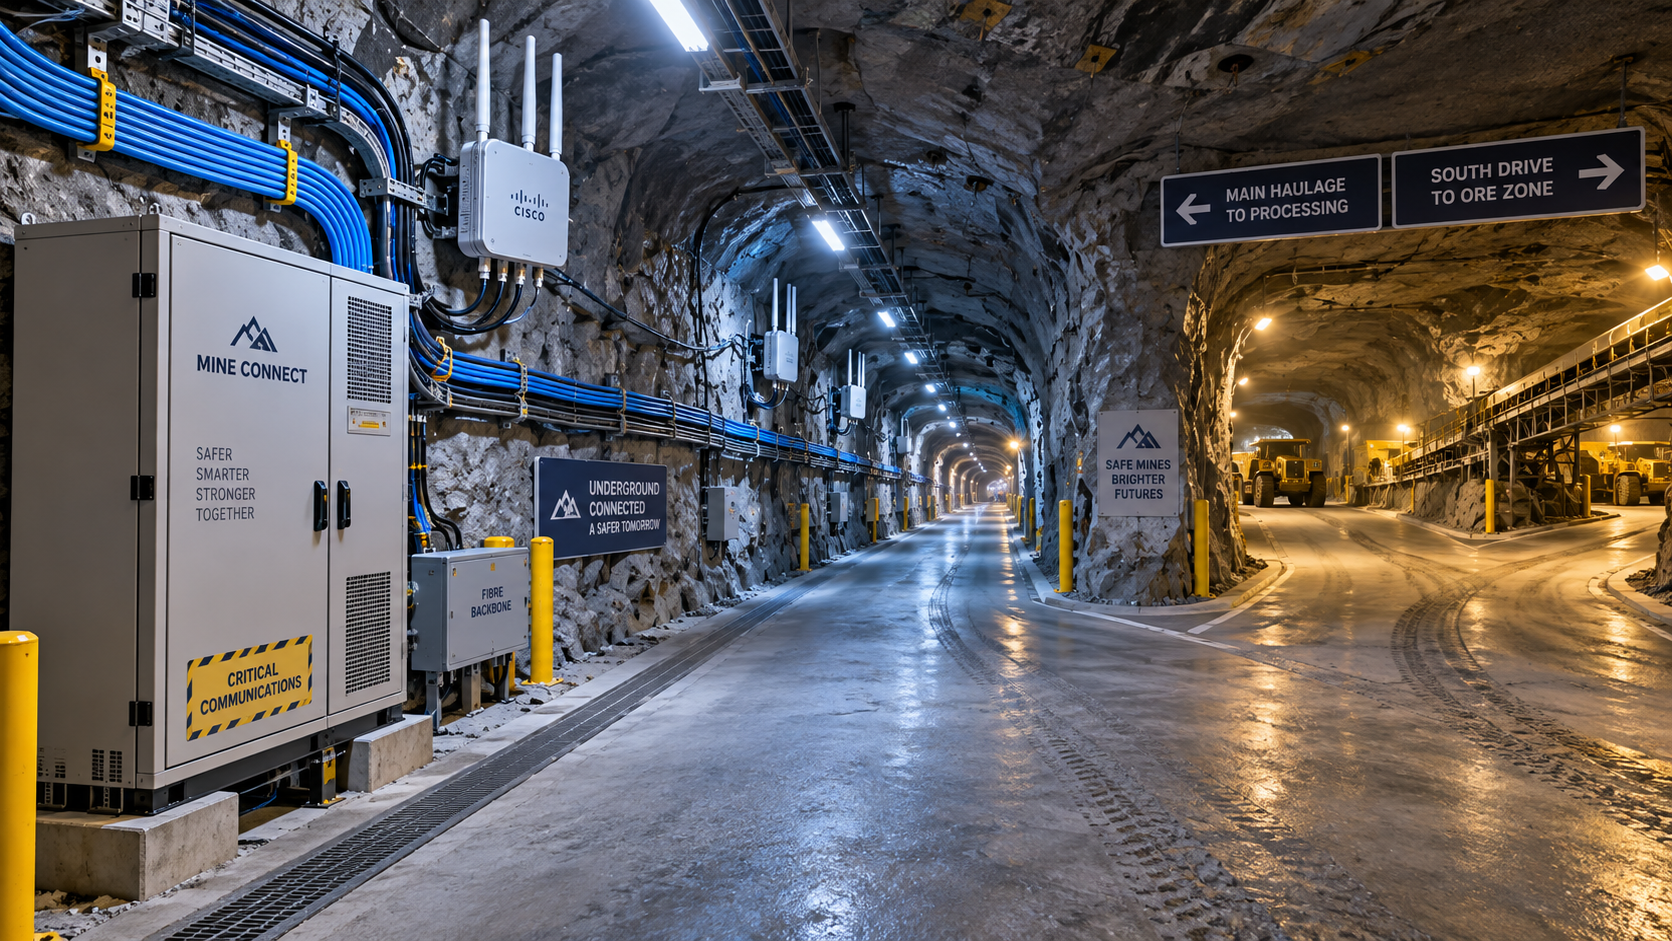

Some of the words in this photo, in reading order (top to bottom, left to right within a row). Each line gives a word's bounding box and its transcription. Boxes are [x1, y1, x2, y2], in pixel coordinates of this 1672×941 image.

[1432, 164, 1491, 183] SOUTH
[1499, 158, 1553, 176] DRIVE
[1227, 186, 1265, 202] MAIN
[1271, 178, 1345, 198] HAULAGE
[1431, 190, 1455, 205] TO
[1461, 186, 1496, 202] ORE
[1503, 181, 1553, 199] ZONE
[514, 206, 545, 221] CISCO
[1226, 209, 1245, 222] TO
[1250, 199, 1349, 221] PROCESSING
[197, 355, 236, 375] MINE
[241, 361, 307, 383] CONNECT
[197, 447, 232, 460] SAFER
[1106, 460, 1132, 470] SAFE
[1137, 460, 1171, 470] MINES
[197, 467, 249, 480] SMARTER
[1112, 474, 1165, 484] BRIGHTER
[197, 488, 255, 501] STRONGER
[590, 481, 659, 495] UNDERGROUND
[1115, 489, 1163, 499] FUTURES
[196, 507, 254, 521] TOGETHER
[590, 501, 645, 516] CONNECTED
[589, 523, 595, 535] A
[597, 521, 619, 534] SAFER
[482, 586, 503, 599] FIBRE
[471, 600, 512, 618] BACKBONE
[227, 662, 279, 687] CRITICAL
[200, 674, 302, 715] COMMUNICATIONS
